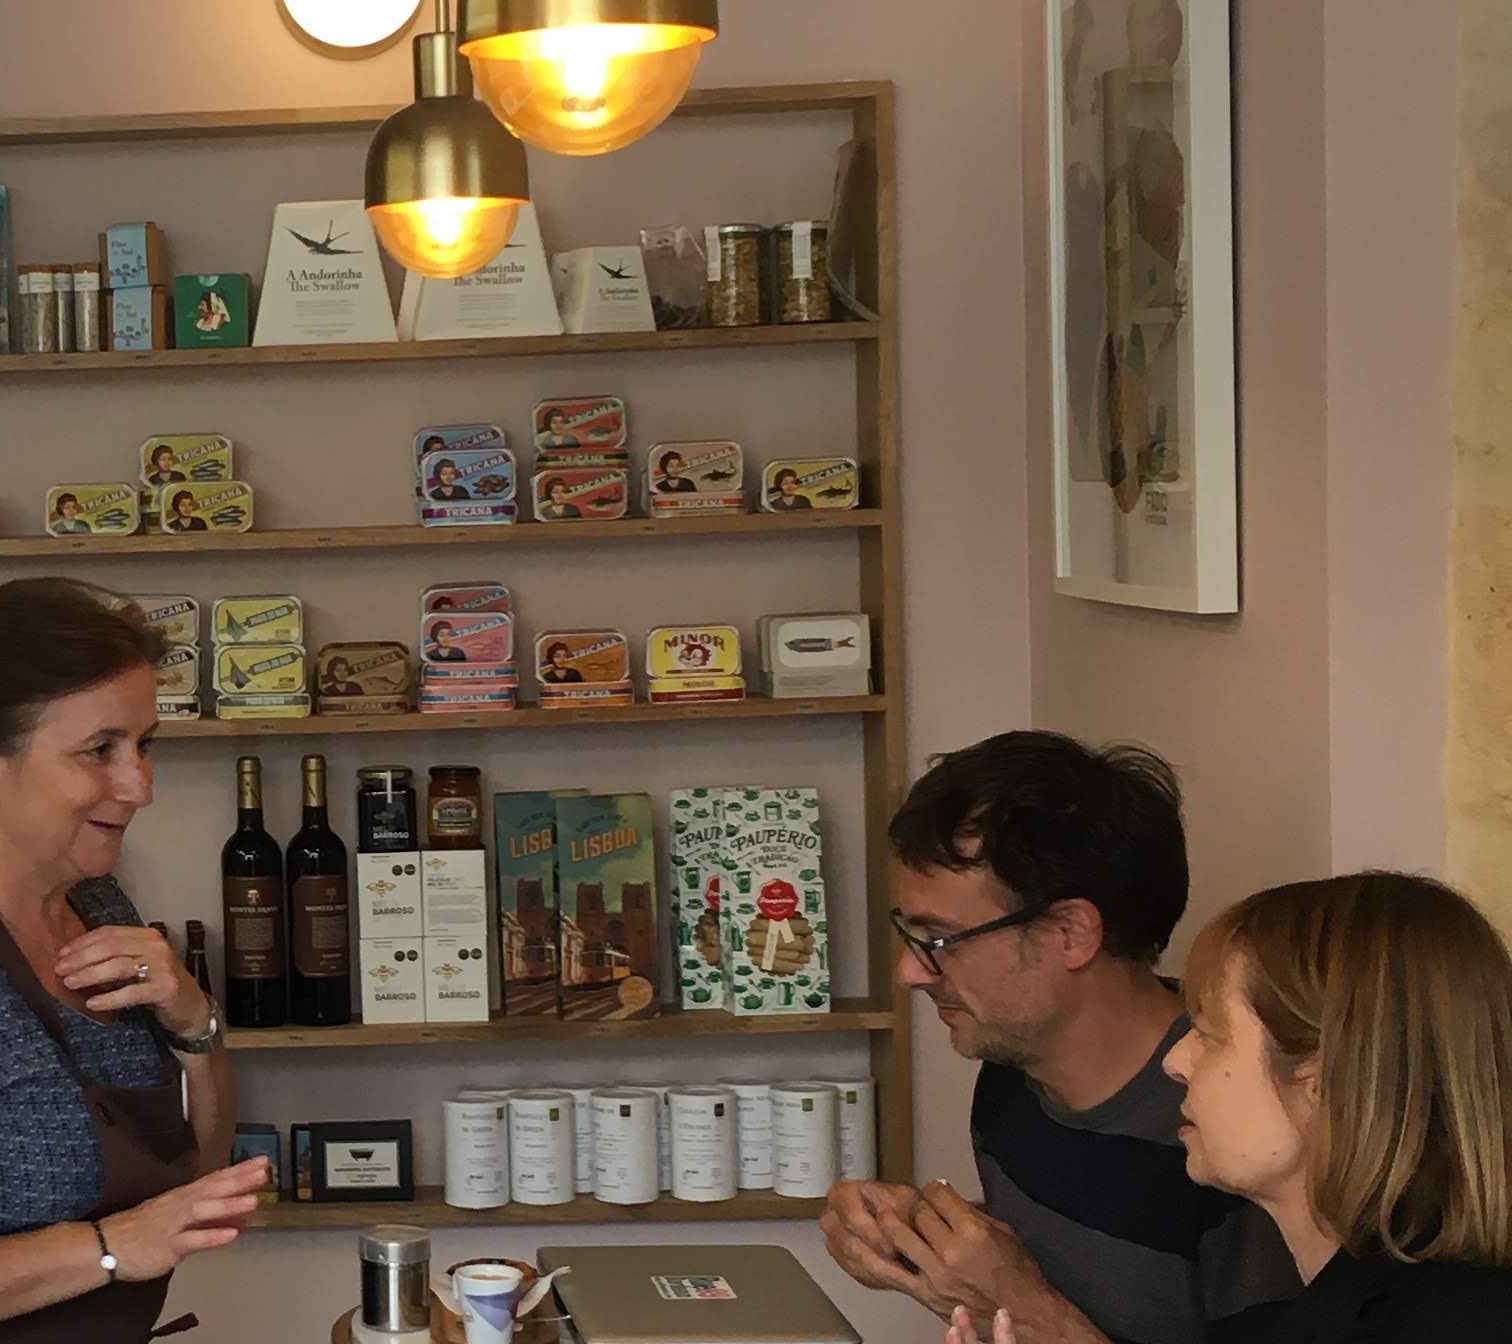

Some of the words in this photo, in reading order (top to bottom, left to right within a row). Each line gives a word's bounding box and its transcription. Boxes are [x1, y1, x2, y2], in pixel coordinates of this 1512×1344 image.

[286, 269, 296, 281] A
[299, 268, 363, 281] Andorinha
[475, 272, 523, 286] Swallow
[290, 280, 310, 292] The
[312, 279, 361, 292] Swallow
[178, 440, 223, 462] TRICANA
[459, 455, 506, 477] TRICANA
[80, 490, 127, 511] TRICANA
[198, 487, 243, 508] TRICANA
[445, 506, 493, 517] TRICANA
[571, 638, 617, 659] TRICANA
[663, 633, 725, 653] MINOR
[372, 831, 410, 840] BARROSO
[509, 828, 553, 860] LISB
[570, 827, 639, 864] LISBOA
[678, 825, 723, 848] PAUP
[729, 825, 818, 851] PAUPÉRIO
[372, 906, 415, 916] BARROSO
[375, 992, 417, 1002] BARROSO
[438, 990, 481, 1000] BARROSO
